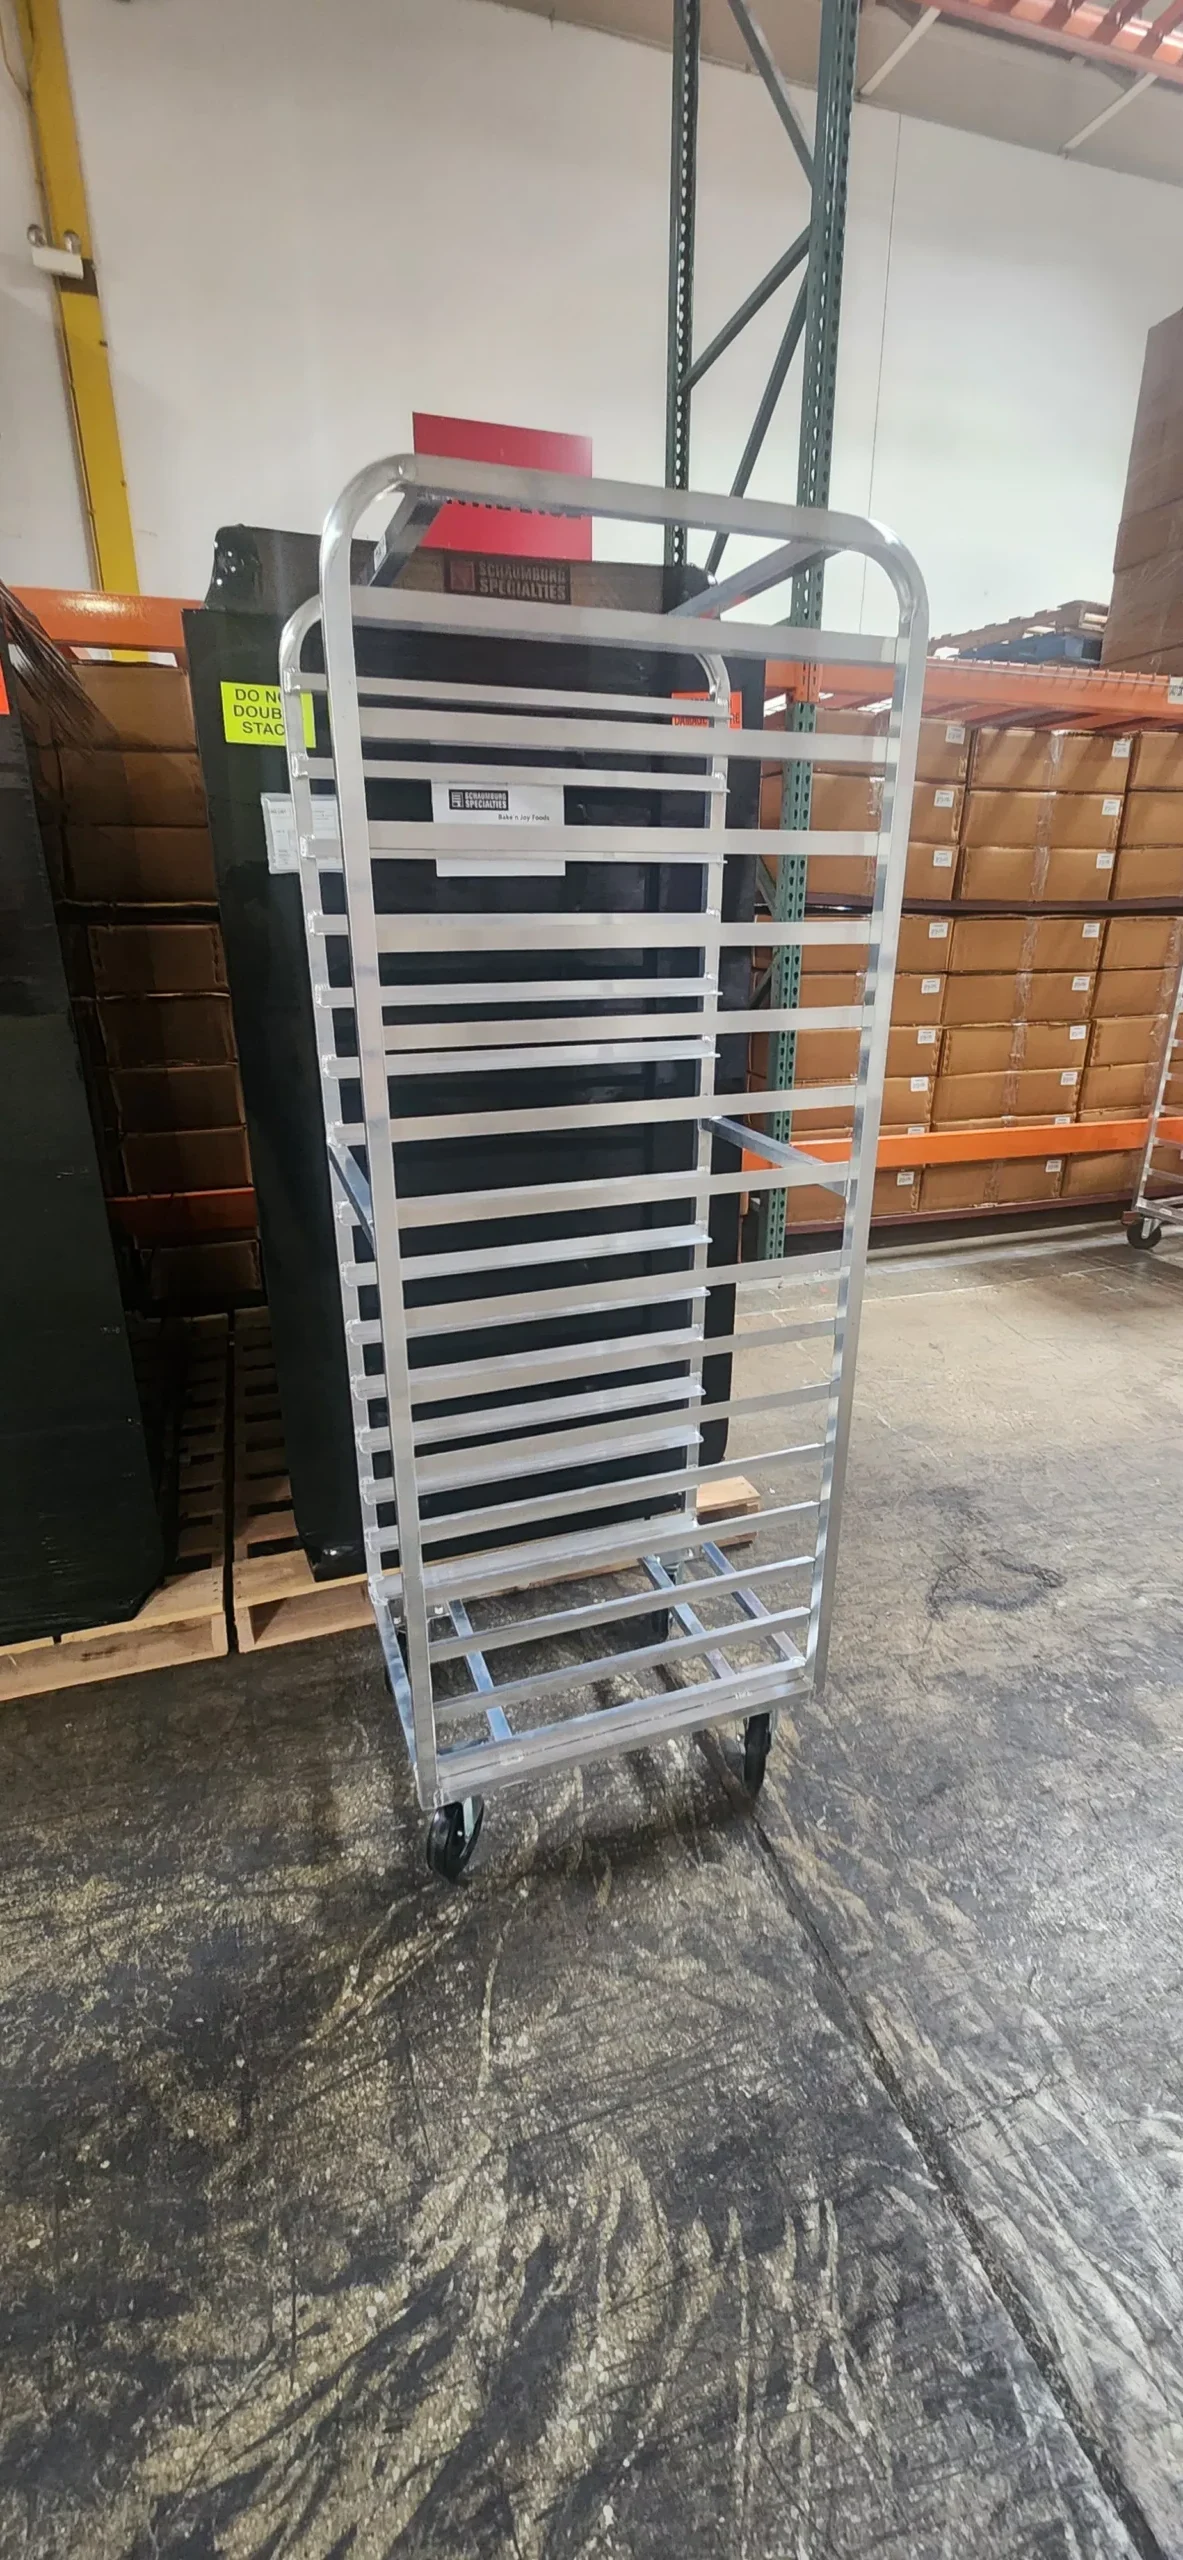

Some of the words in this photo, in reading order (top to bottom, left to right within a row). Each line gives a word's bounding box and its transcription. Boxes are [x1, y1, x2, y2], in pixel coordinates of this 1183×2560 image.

[479, 560, 566, 584] SCHAUMBURG
[479, 579, 566, 600] SPECIALTIES
[234, 688, 260, 702] DO
[464, 791, 507, 801] SCHAUMBURG
[465, 799, 507, 809] SPECIALTIES
[519, 814, 531, 822] Joy
